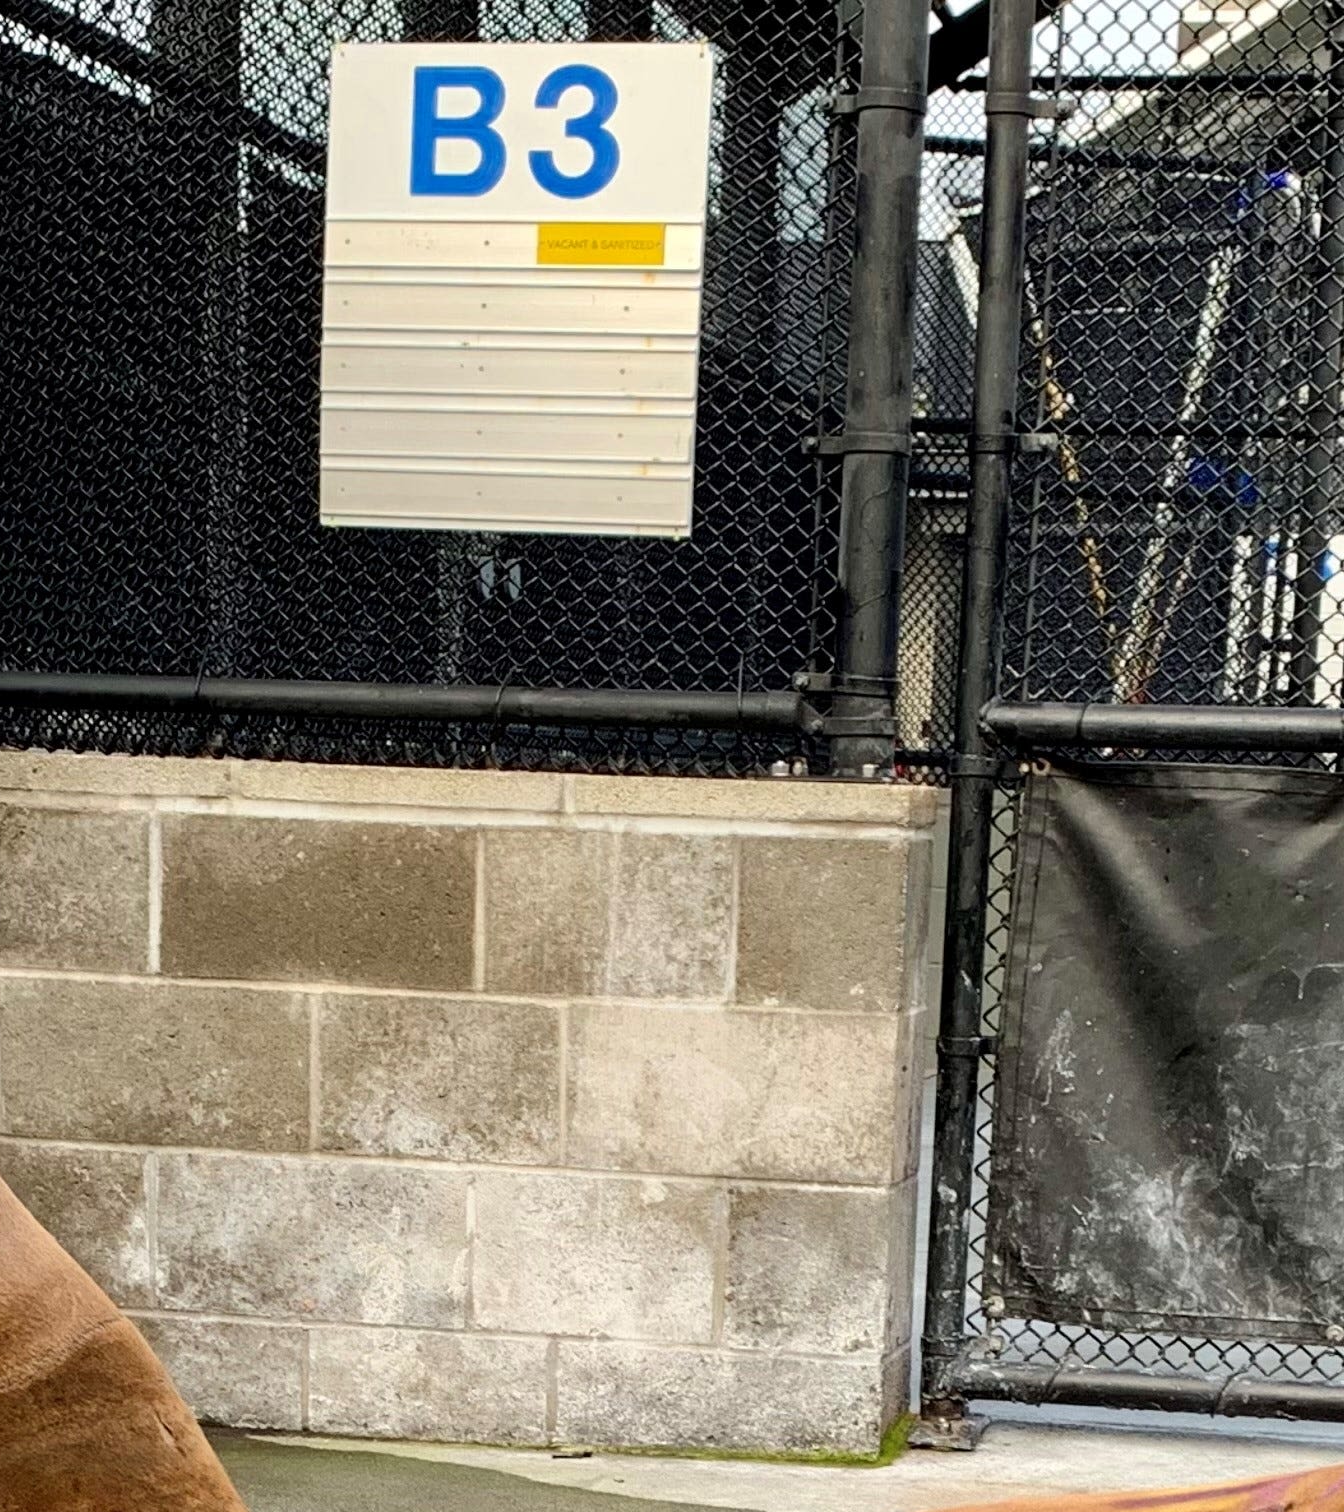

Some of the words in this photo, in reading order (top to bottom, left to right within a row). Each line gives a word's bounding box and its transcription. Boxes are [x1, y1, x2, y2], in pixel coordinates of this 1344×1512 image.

[410, 63, 621, 200] B3
[547, 239, 588, 249] VACANT
[600, 239, 655, 249] SANITIZED
